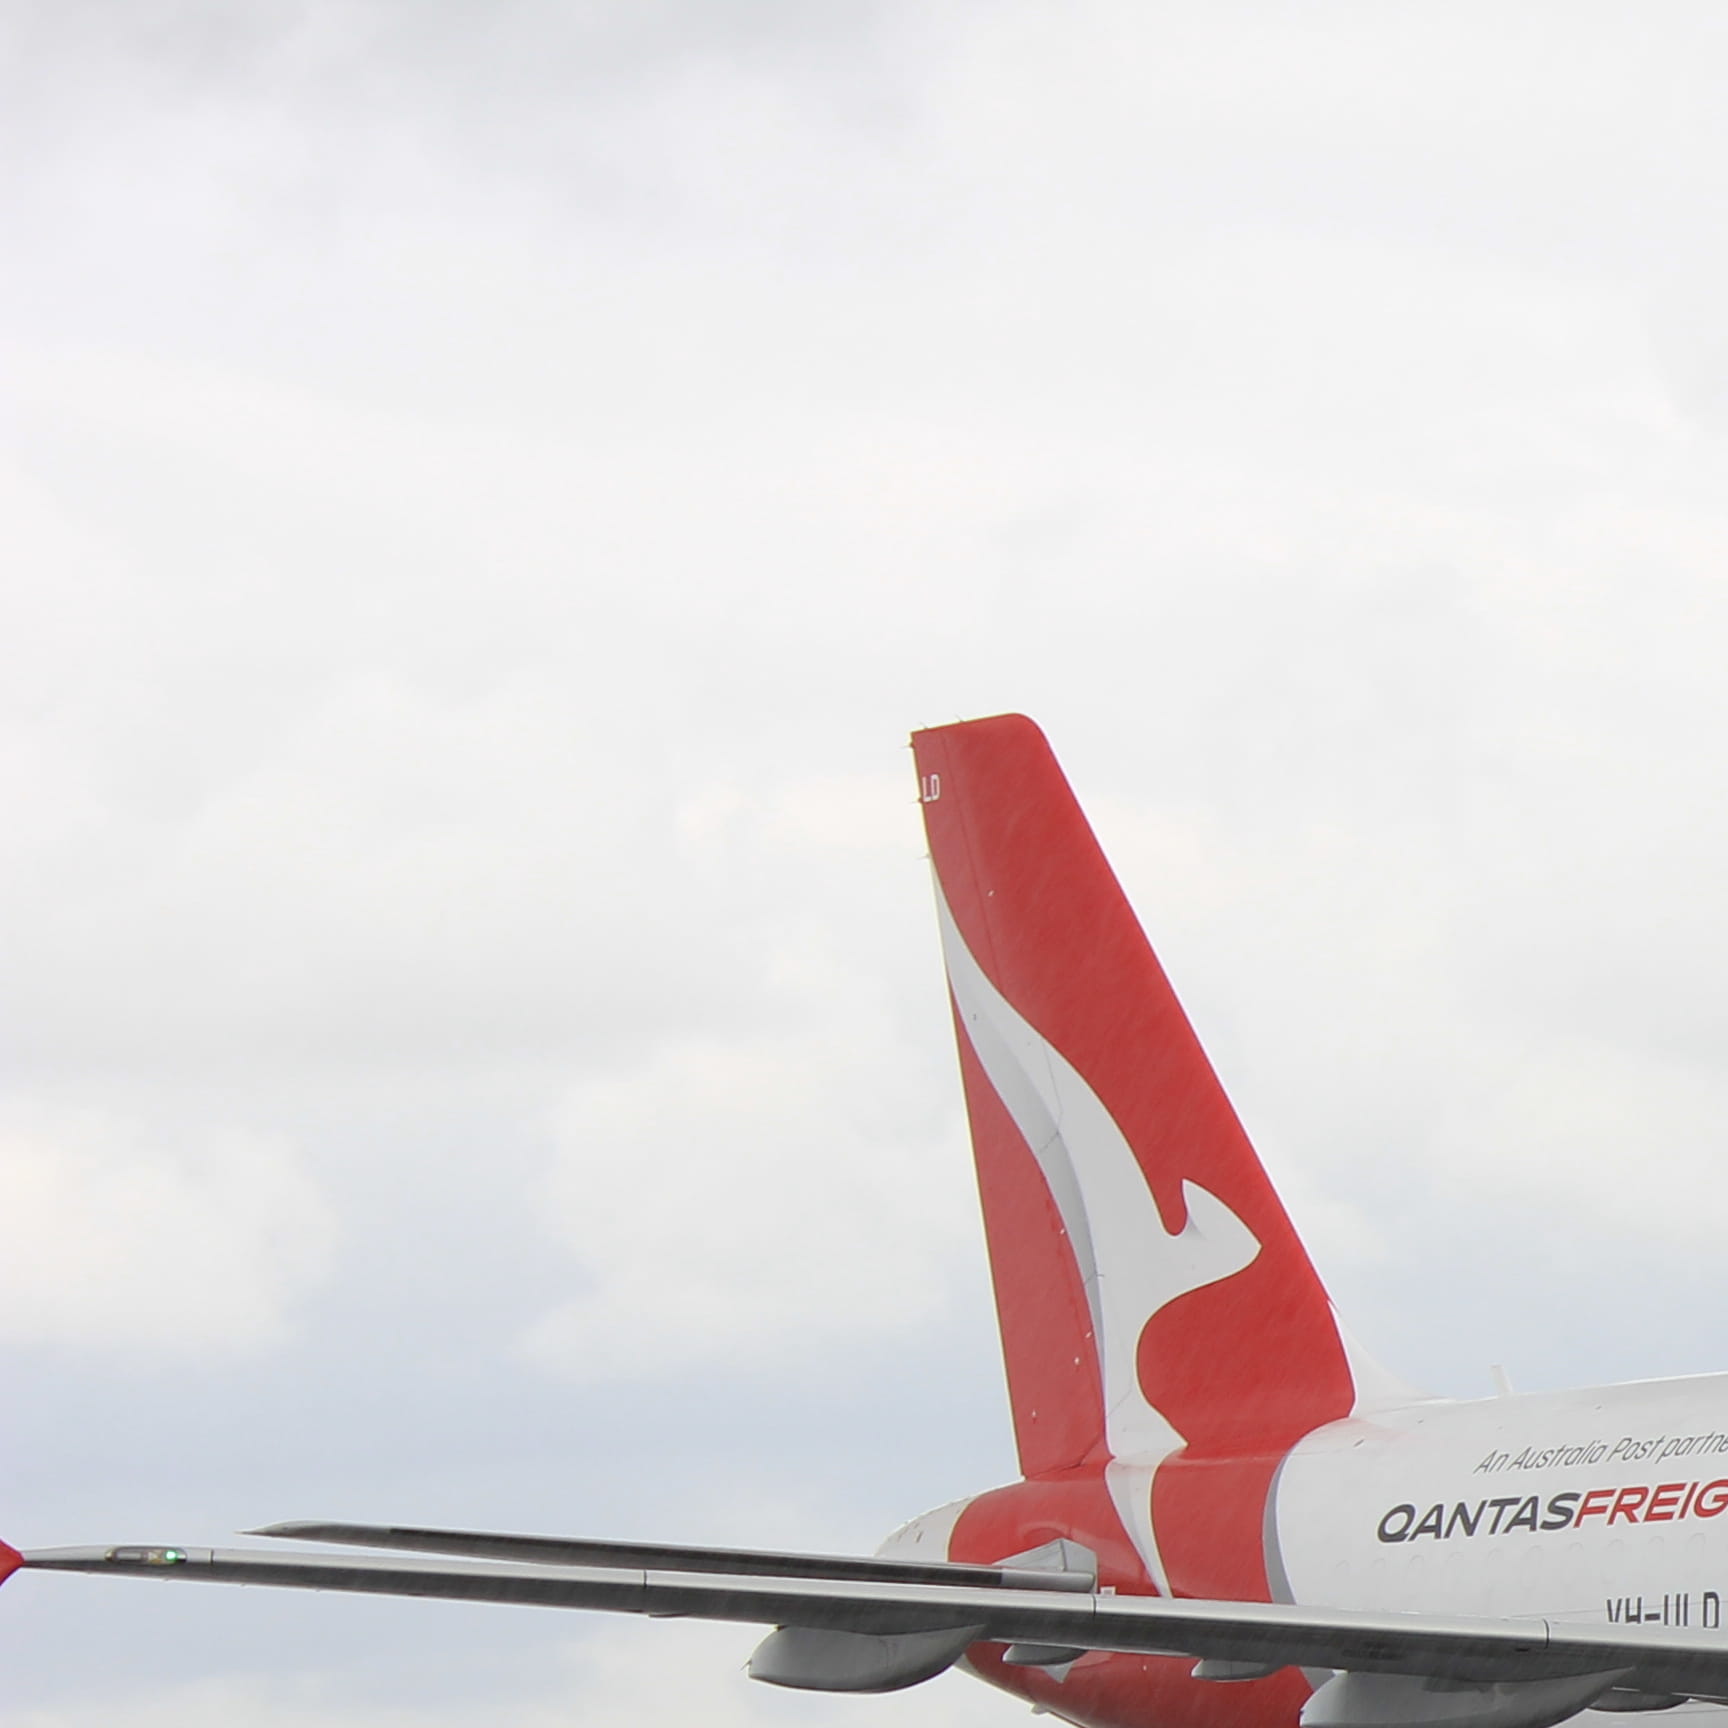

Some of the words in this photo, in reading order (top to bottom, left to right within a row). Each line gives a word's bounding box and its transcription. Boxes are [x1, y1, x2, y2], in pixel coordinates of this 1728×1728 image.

[921, 773, 940, 803] LD
[1473, 1449, 1507, 1475] An
[1506, 1439, 1606, 1472] Australia
[1606, 1435, 1664, 1463] Post
